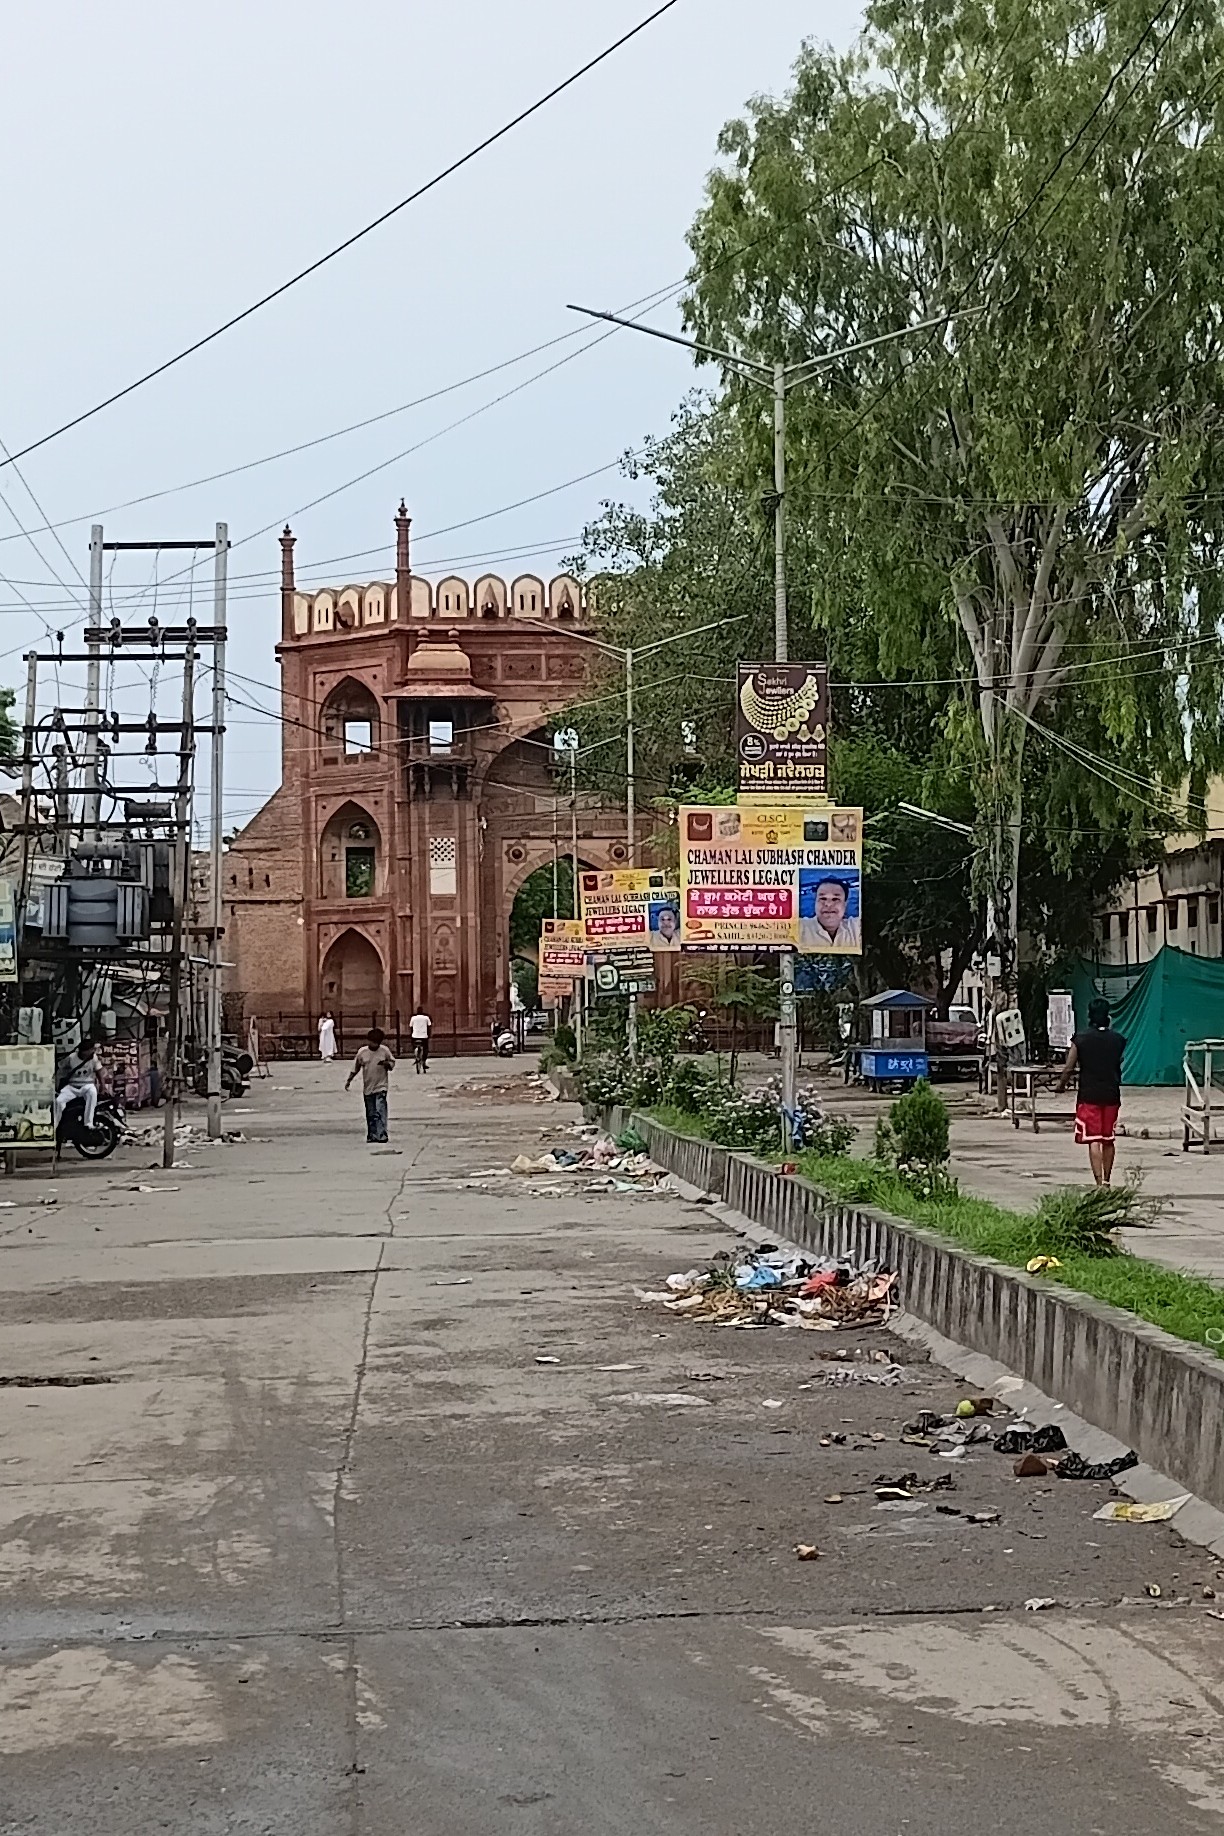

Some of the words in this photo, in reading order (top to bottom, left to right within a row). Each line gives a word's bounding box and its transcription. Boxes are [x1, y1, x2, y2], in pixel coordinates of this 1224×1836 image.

[688, 849, 731, 865] CHAMAN
[735, 849, 754, 864] LAL
[757, 849, 804, 866] SUBHASH
[807, 850, 857, 866] CHANDER
[688, 869, 750, 885] JEWELLERS
[753, 869, 795, 886] LEGACY
